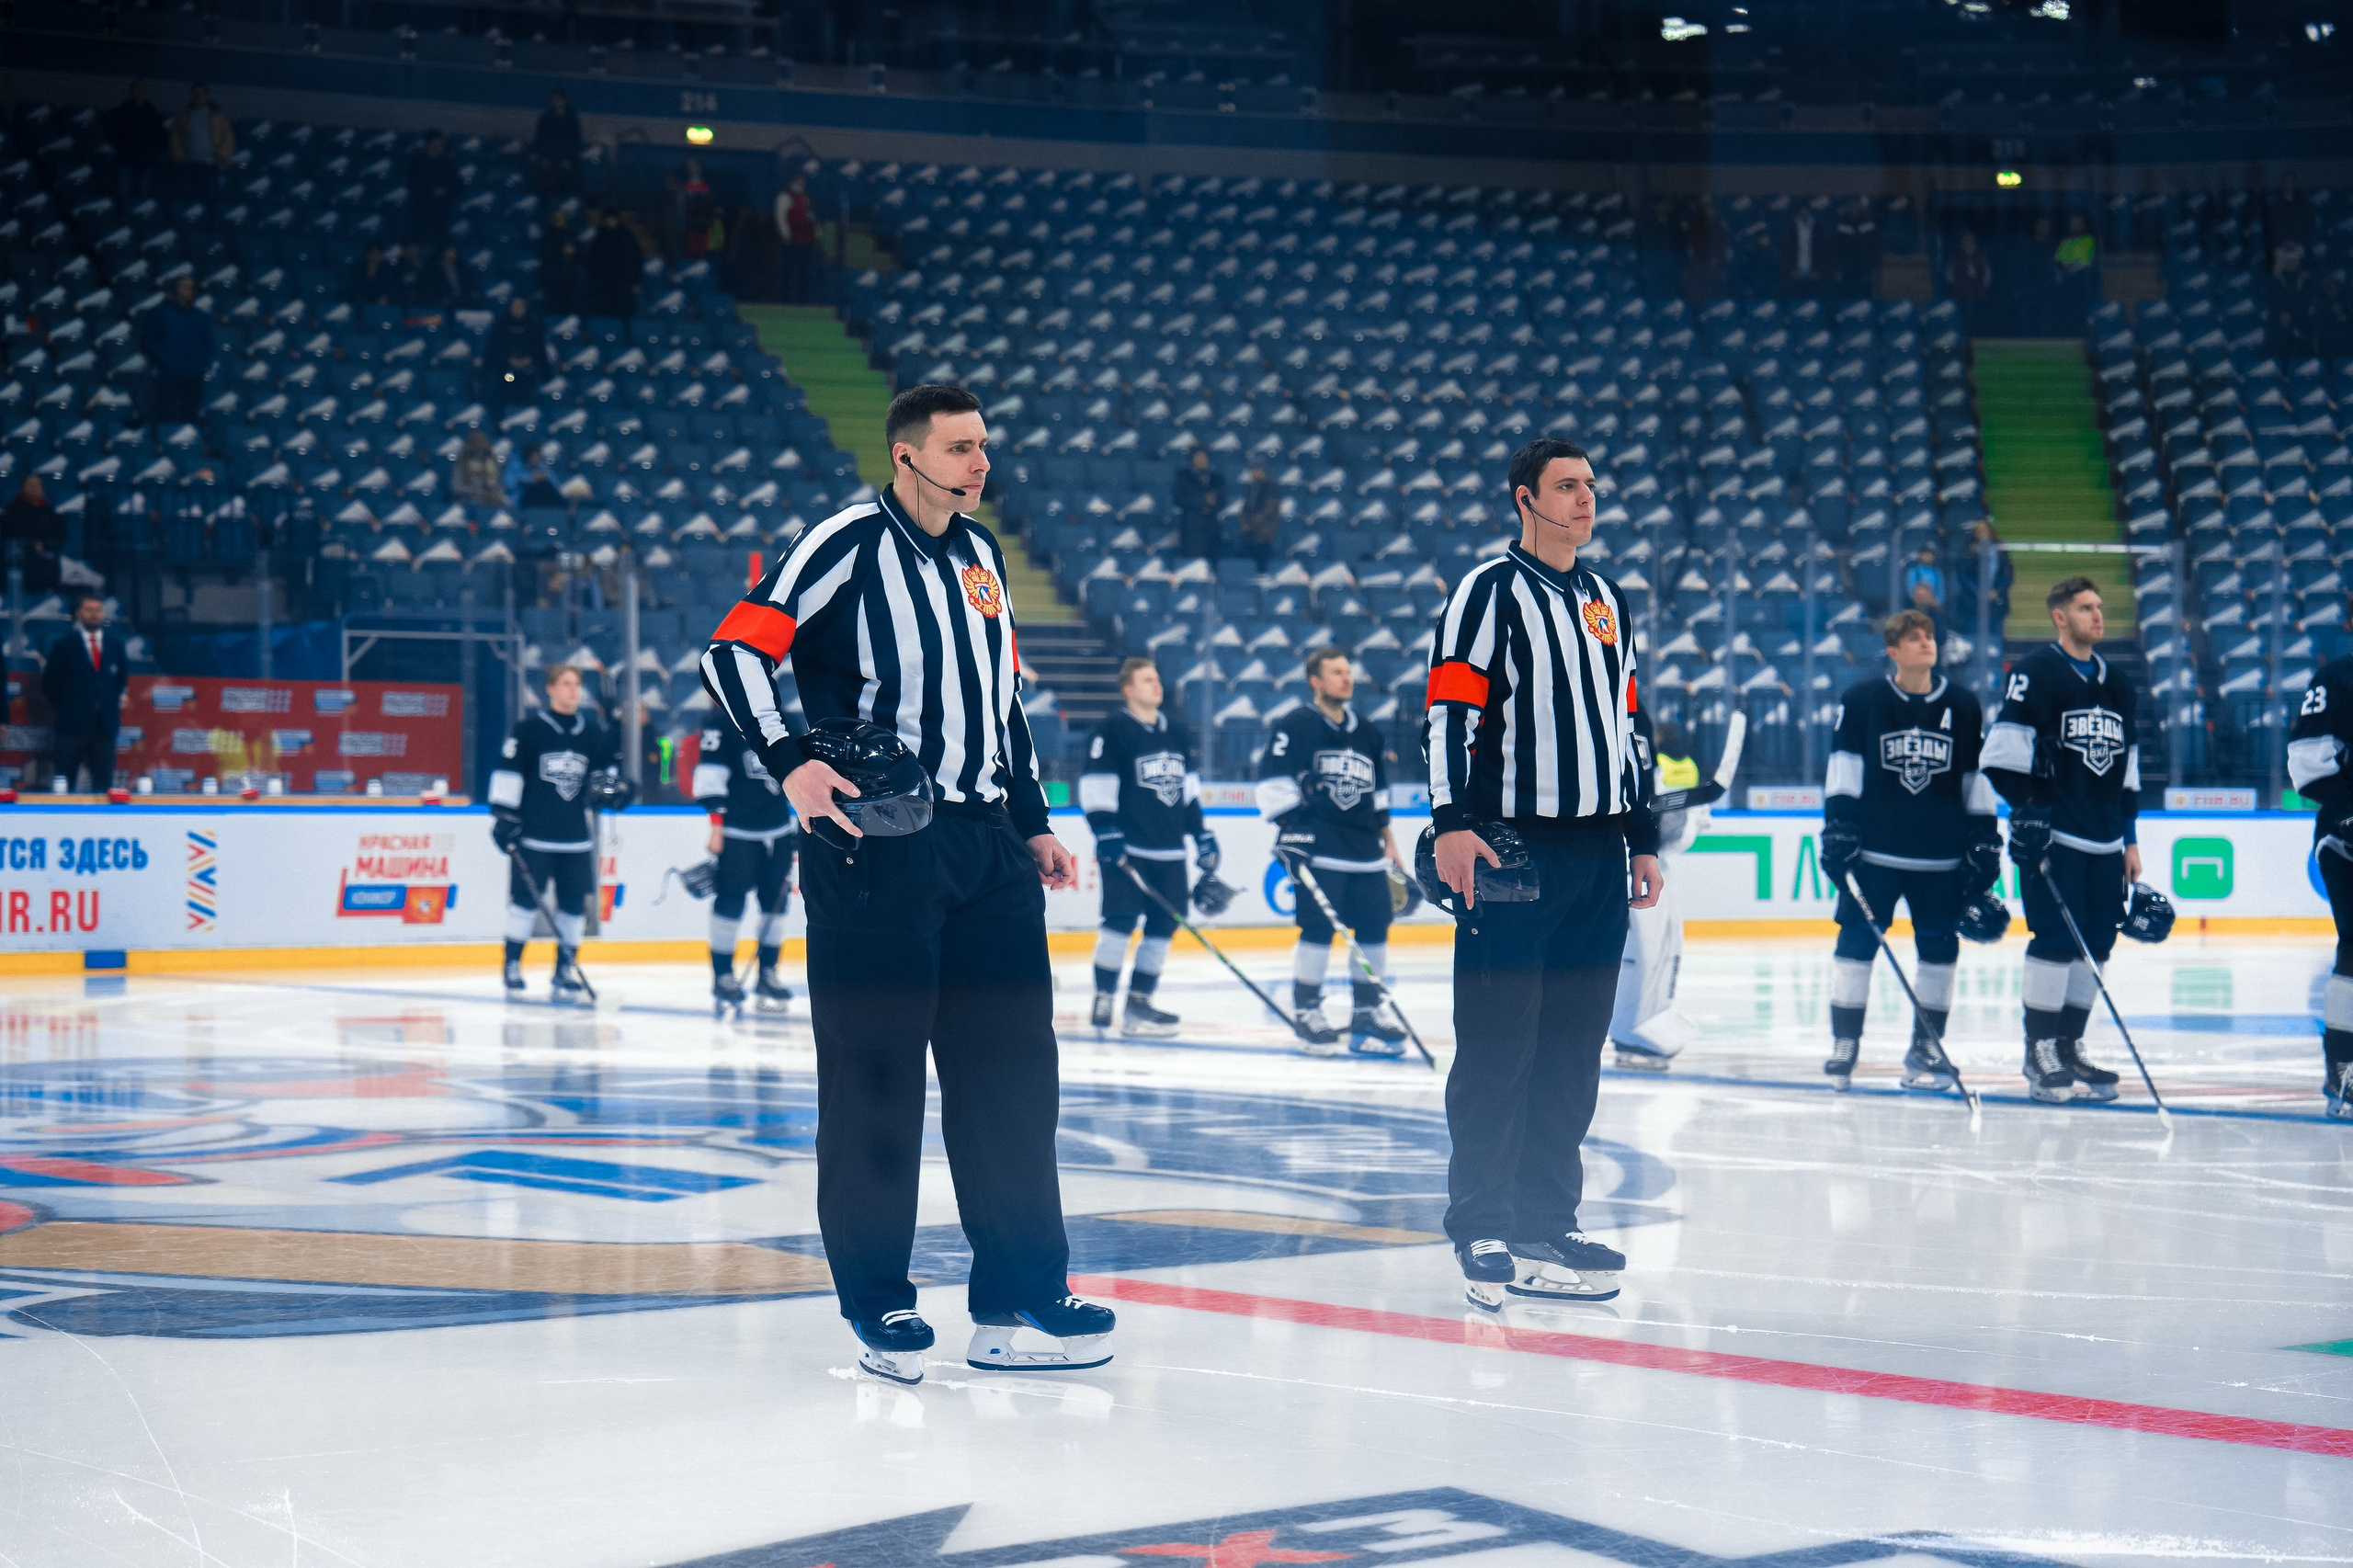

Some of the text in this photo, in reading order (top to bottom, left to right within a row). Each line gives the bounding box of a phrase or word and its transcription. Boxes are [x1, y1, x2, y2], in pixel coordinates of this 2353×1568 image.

[2301, 685, 2326, 716] 23
[1939, 707, 1951, 731] A
[58, 837, 148, 875] ЗДЕСЬ
[355, 856, 449, 879] МАШИНА
[0, 890, 99, 933] R.RU
